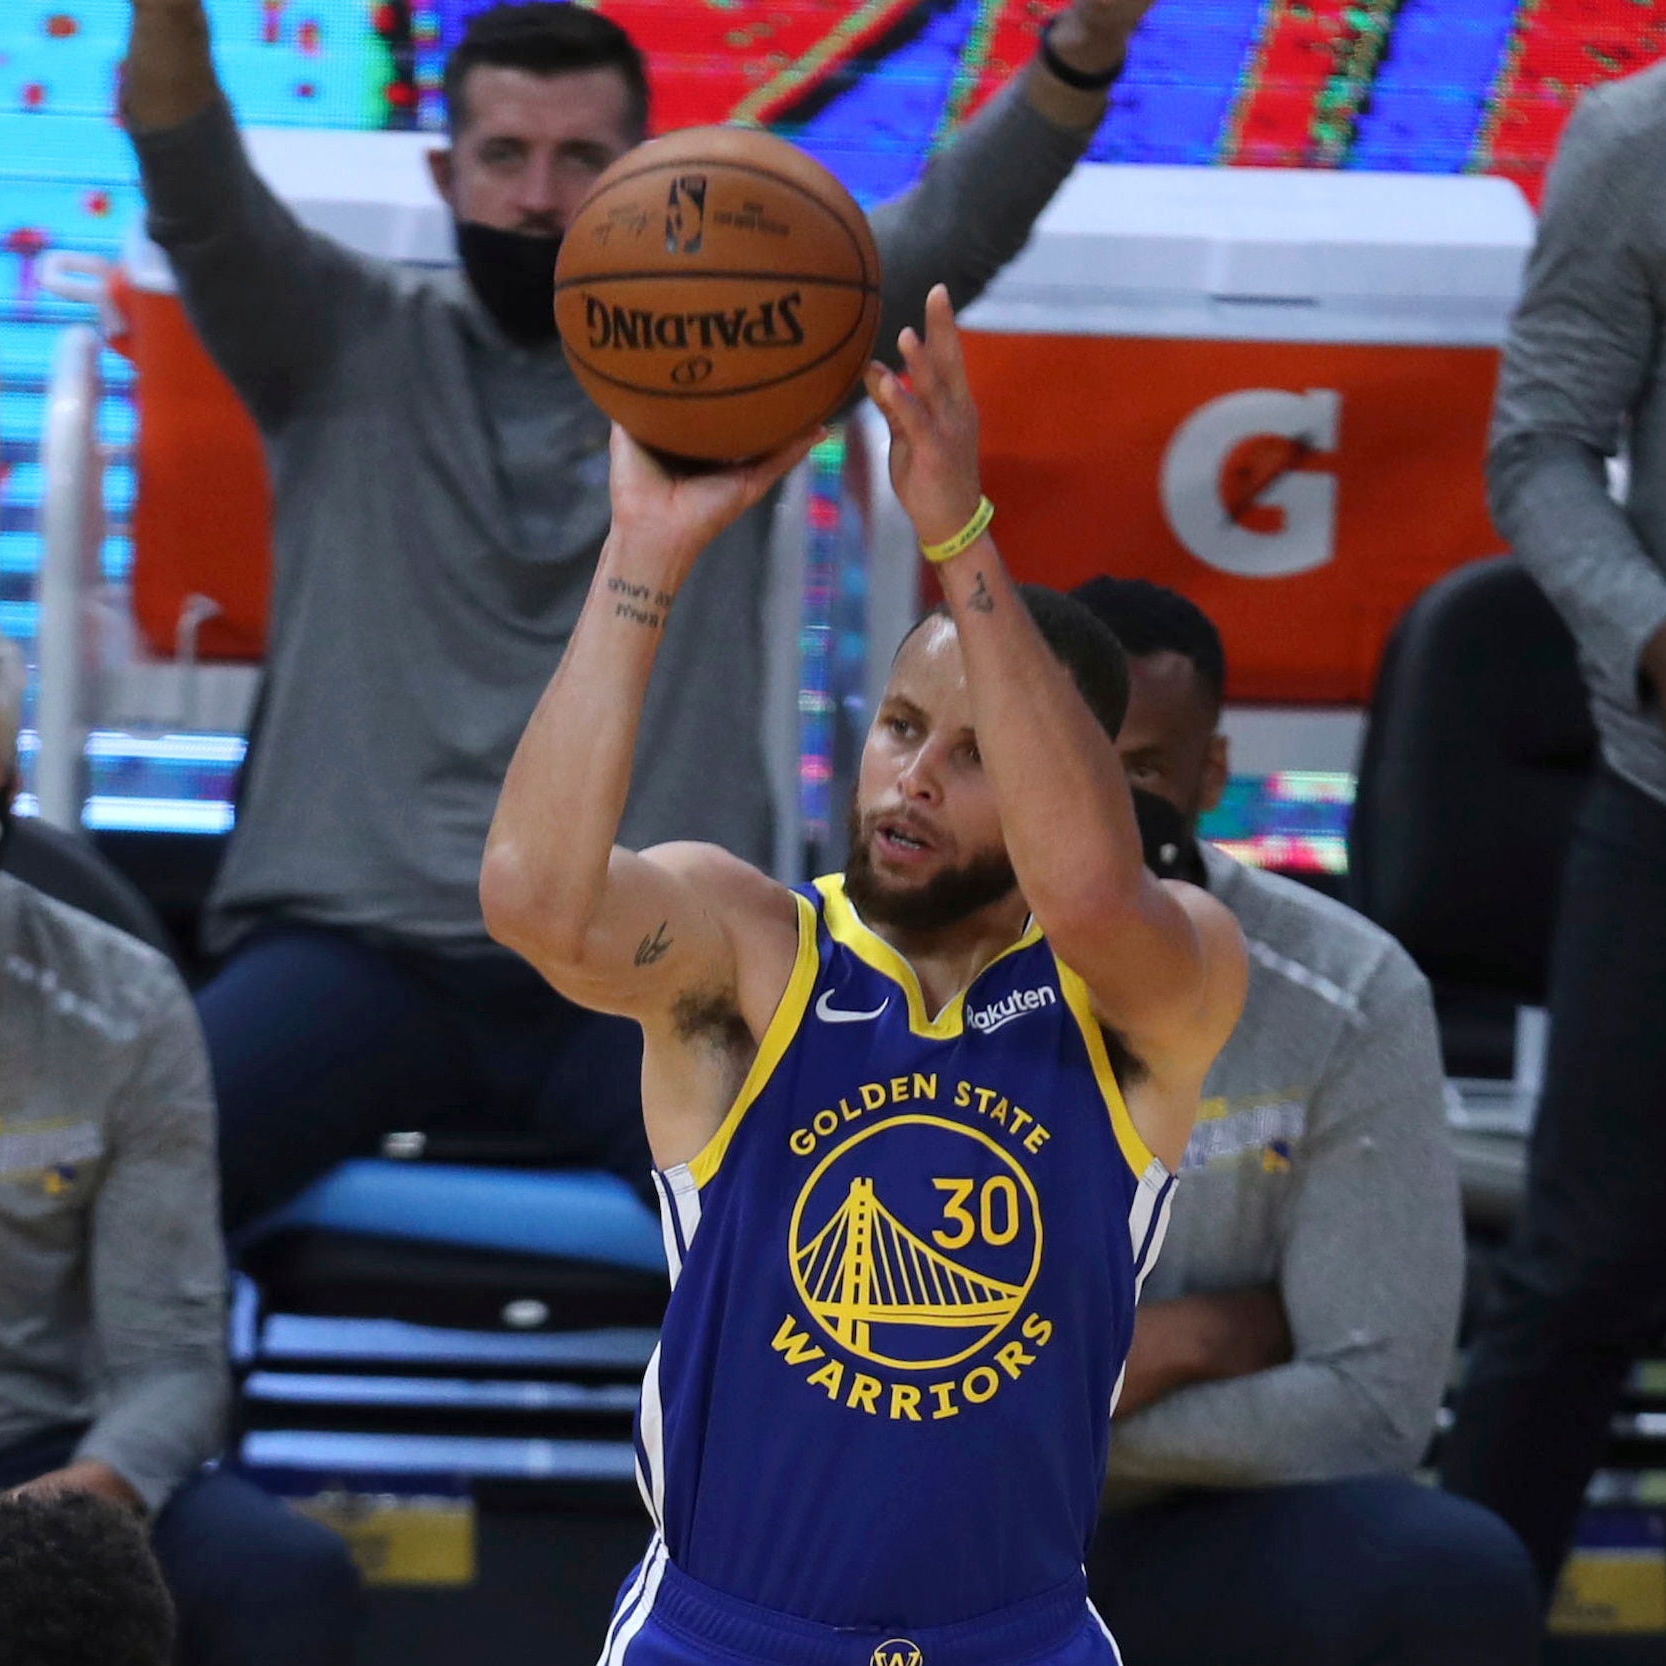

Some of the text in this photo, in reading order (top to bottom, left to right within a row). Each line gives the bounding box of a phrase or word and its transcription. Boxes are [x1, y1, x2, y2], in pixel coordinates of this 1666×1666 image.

[583, 291, 805, 350] SPALDING
[1159, 386, 1342, 580] G
[965, 984, 1057, 1035] Rakuten
[788, 1072, 1052, 1158] GOLDEN STATE
[930, 1174, 1020, 1250] 30
[770, 1311, 1055, 1422] WARRIORS
